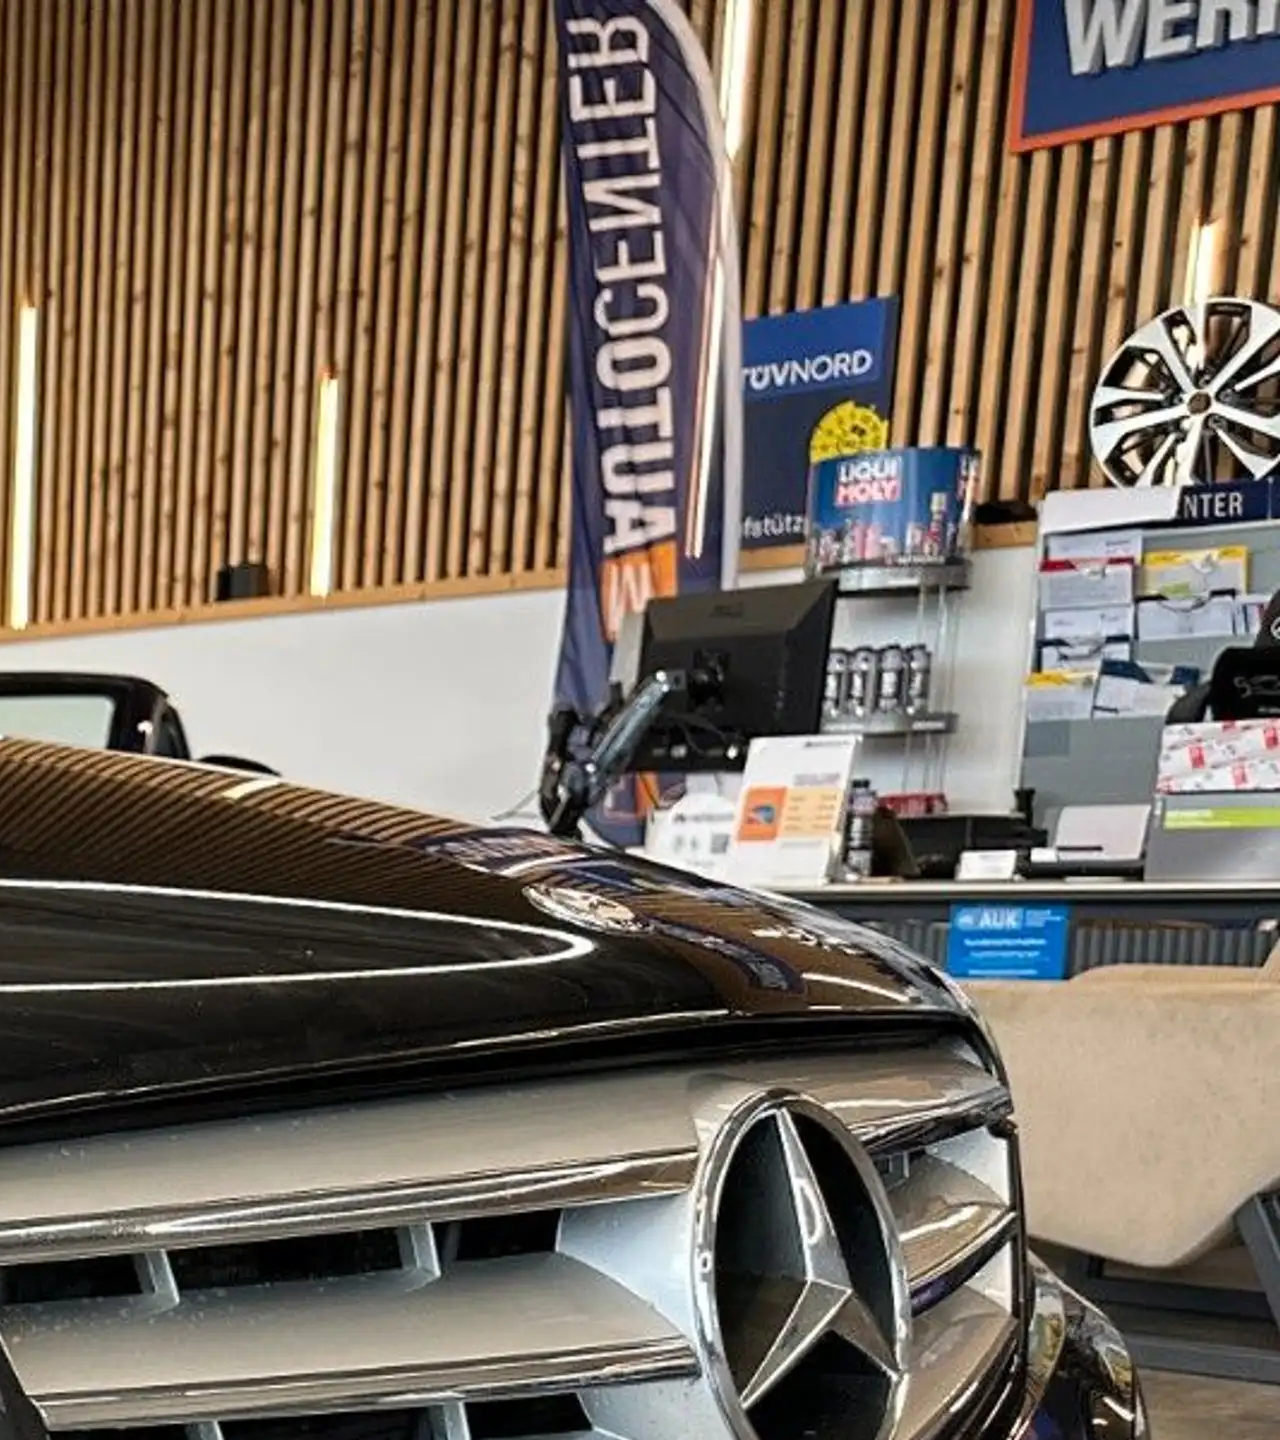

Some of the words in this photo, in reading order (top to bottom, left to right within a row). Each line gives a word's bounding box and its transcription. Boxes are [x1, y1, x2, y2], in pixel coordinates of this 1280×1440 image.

[1064, 0, 1280, 76] WER
[840, 457, 899, 481] LIQUI
[836, 480, 900, 504] MOLY
[1176, 491, 1244, 519] NTER
